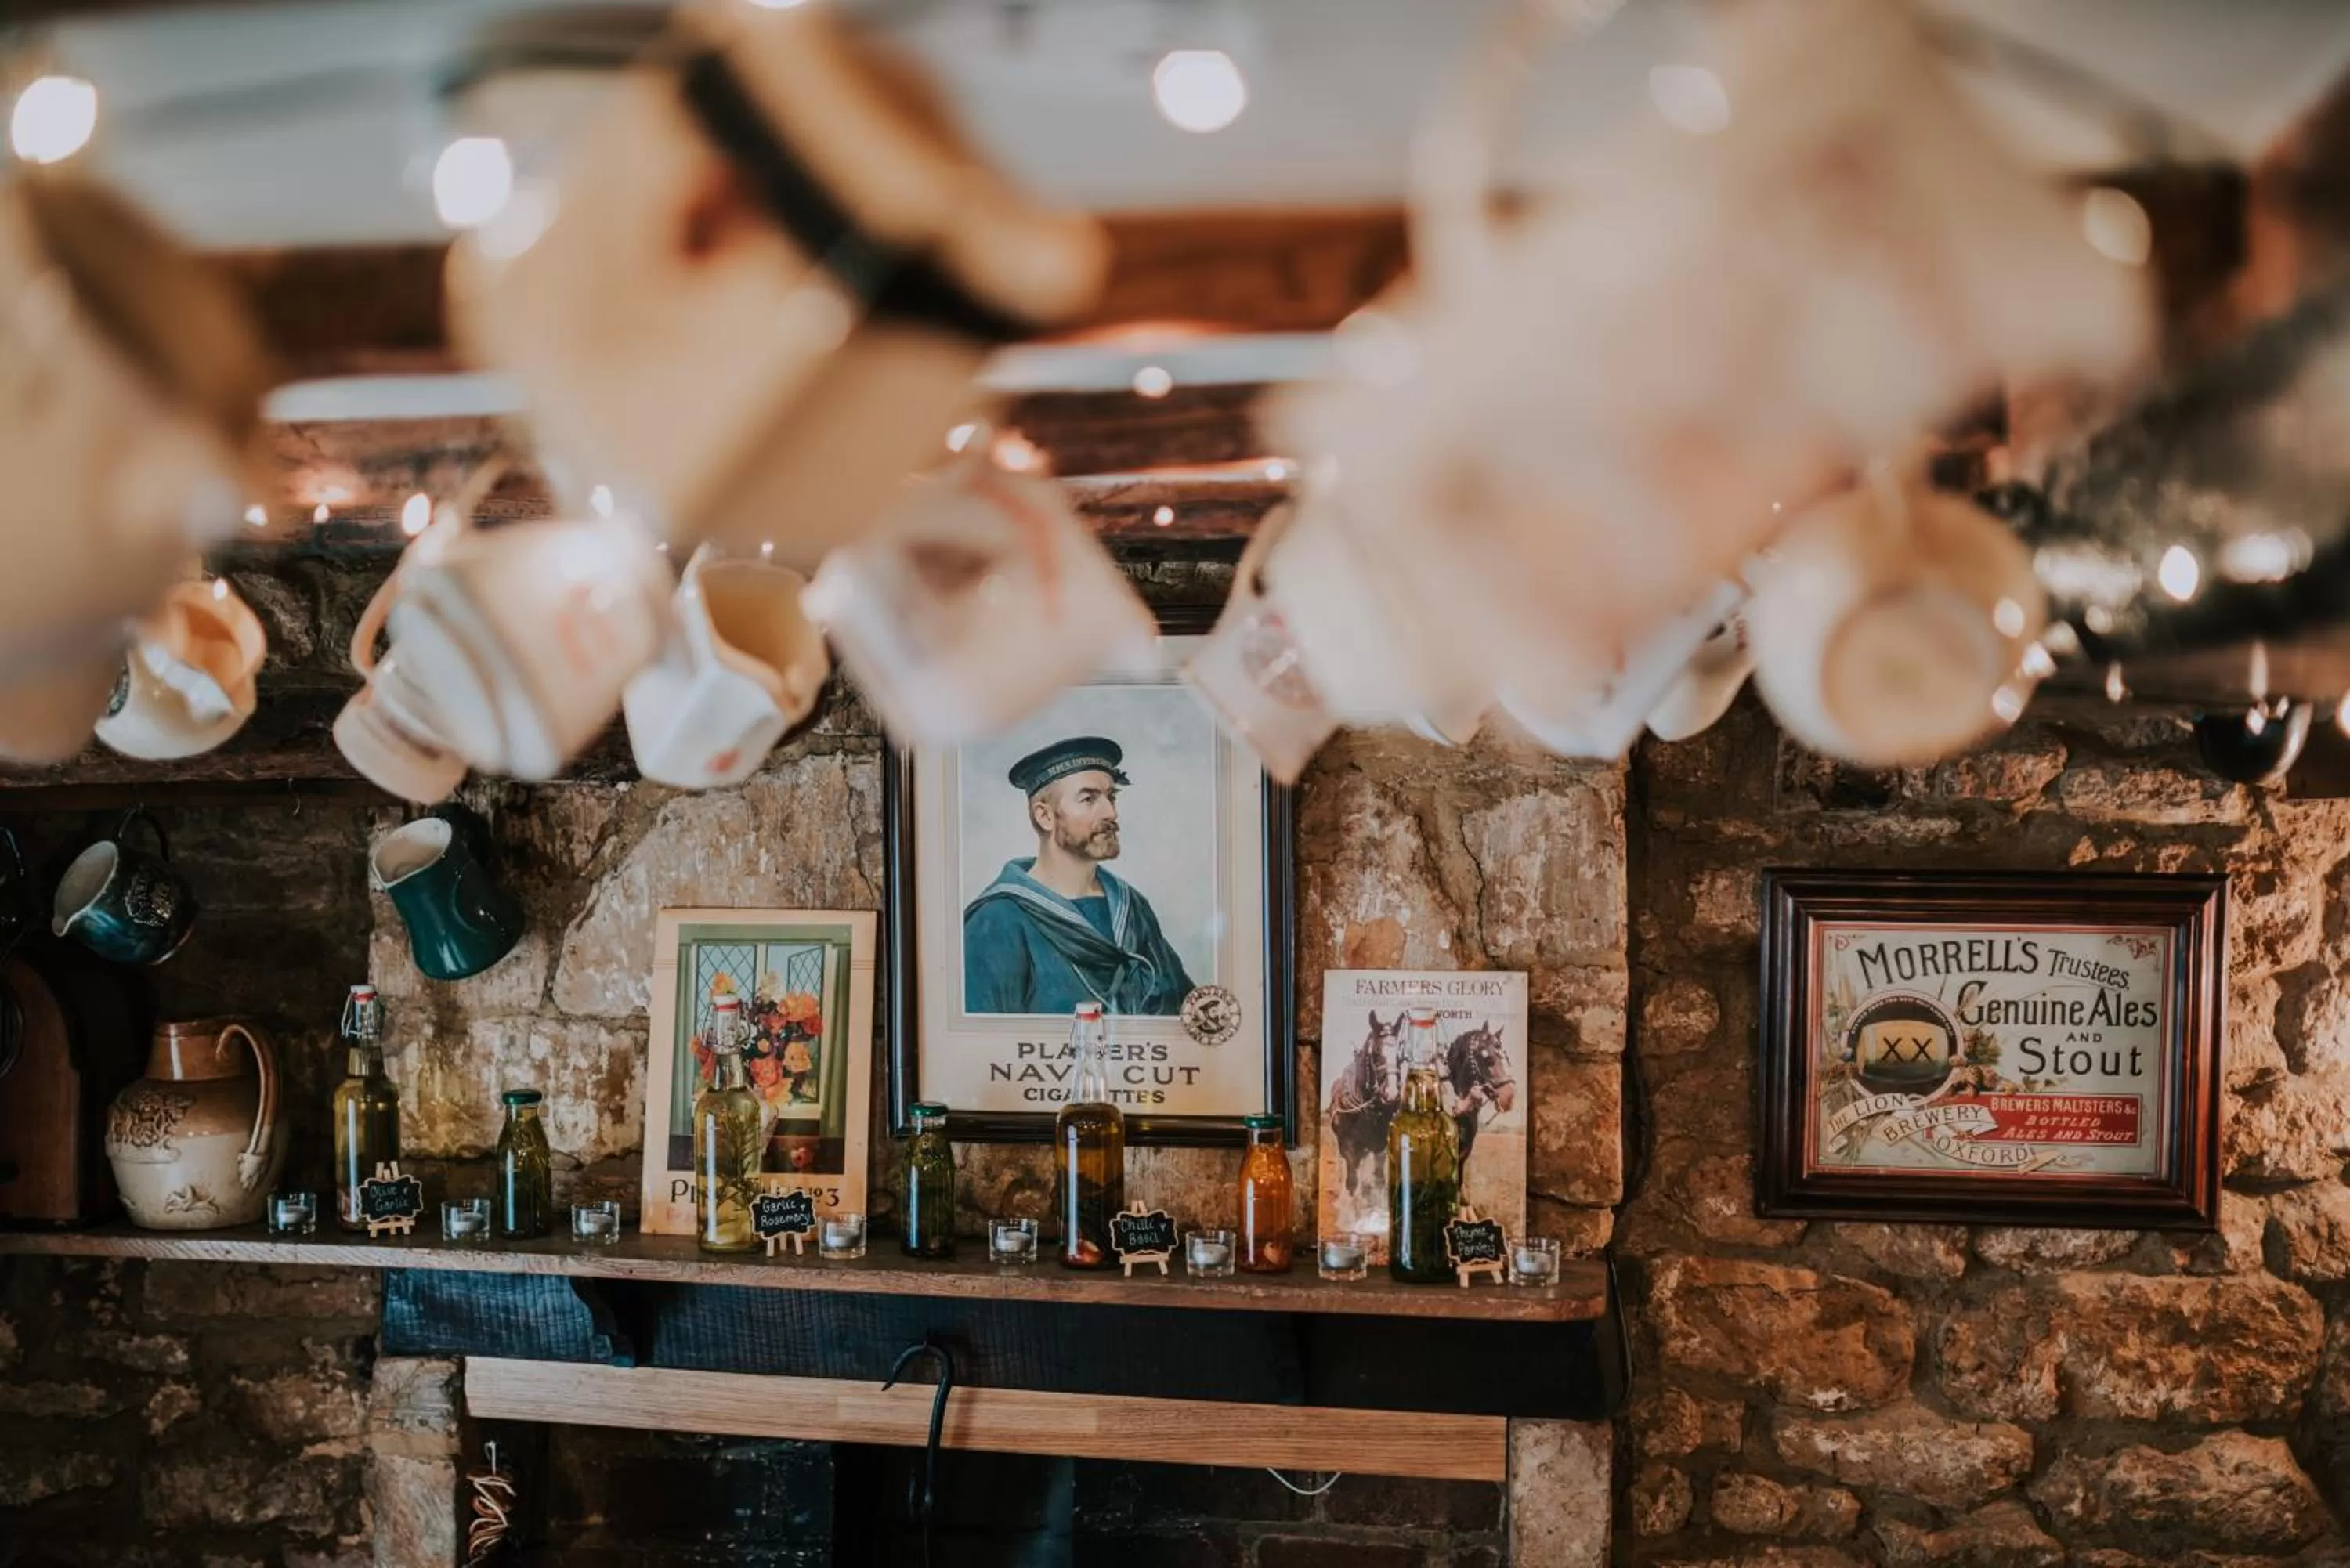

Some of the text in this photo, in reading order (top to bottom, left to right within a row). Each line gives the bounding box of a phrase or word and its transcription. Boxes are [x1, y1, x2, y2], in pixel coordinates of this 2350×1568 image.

[1856, 936, 2130, 991] MORRELL'S Trustees.
[1447, 979, 1506, 996] GLORY
[1958, 980, 2084, 1026] Genuine
[2087, 987, 2158, 1028] Ales
[2065, 1032, 2103, 1042] AND
[1018, 1041, 1168, 1061] PLAER'S
[2018, 1037, 2143, 1077] Stout
[989, 1062, 1201, 1086] NAV CUT
[1854, 1095, 1904, 1117] LION
[1990, 1097, 2050, 1112] BREWERS
[2052, 1098, 2122, 1114] MALTSTERS
[1883, 1106, 1984, 1141] BREWERY
[2001, 1125, 2048, 1140] ALES
[2053, 1130, 2083, 1140] AND
[1936, 1136, 2028, 1163] OXFORD
[762, 1199, 797, 1213] Garlic
[825, 1187, 841, 1207] 3
[761, 1212, 810, 1227] Rosemary
